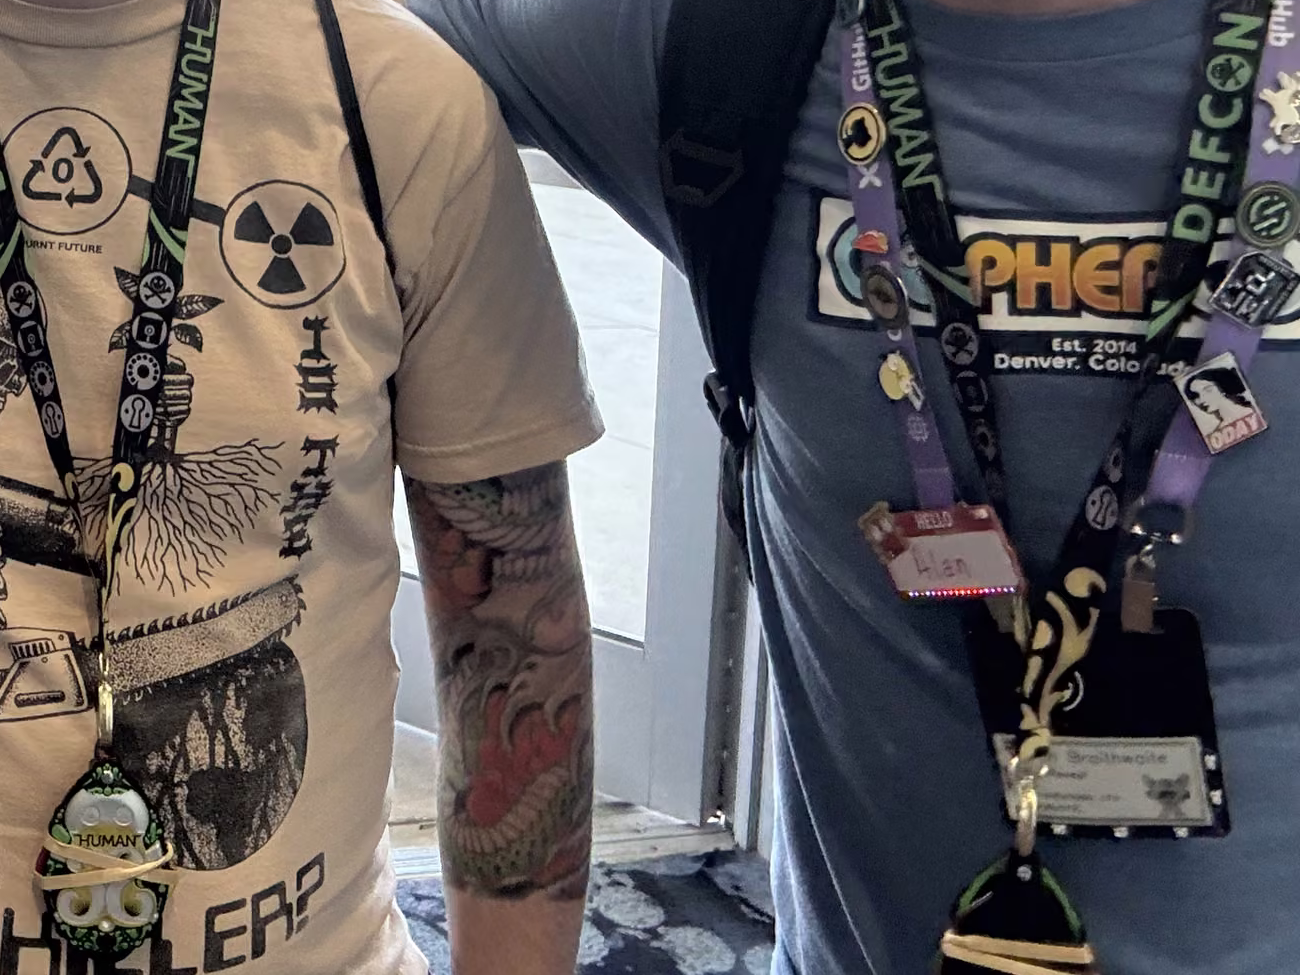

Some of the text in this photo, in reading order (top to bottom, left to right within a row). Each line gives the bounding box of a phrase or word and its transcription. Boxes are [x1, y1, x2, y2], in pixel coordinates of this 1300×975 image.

[165, 22, 219, 183] HUMAN
[25, 239, 102, 254] URNT FUTURE
[1051, 337, 1137, 354] Est. 2014
[72, 833, 141, 847] HUMAN
